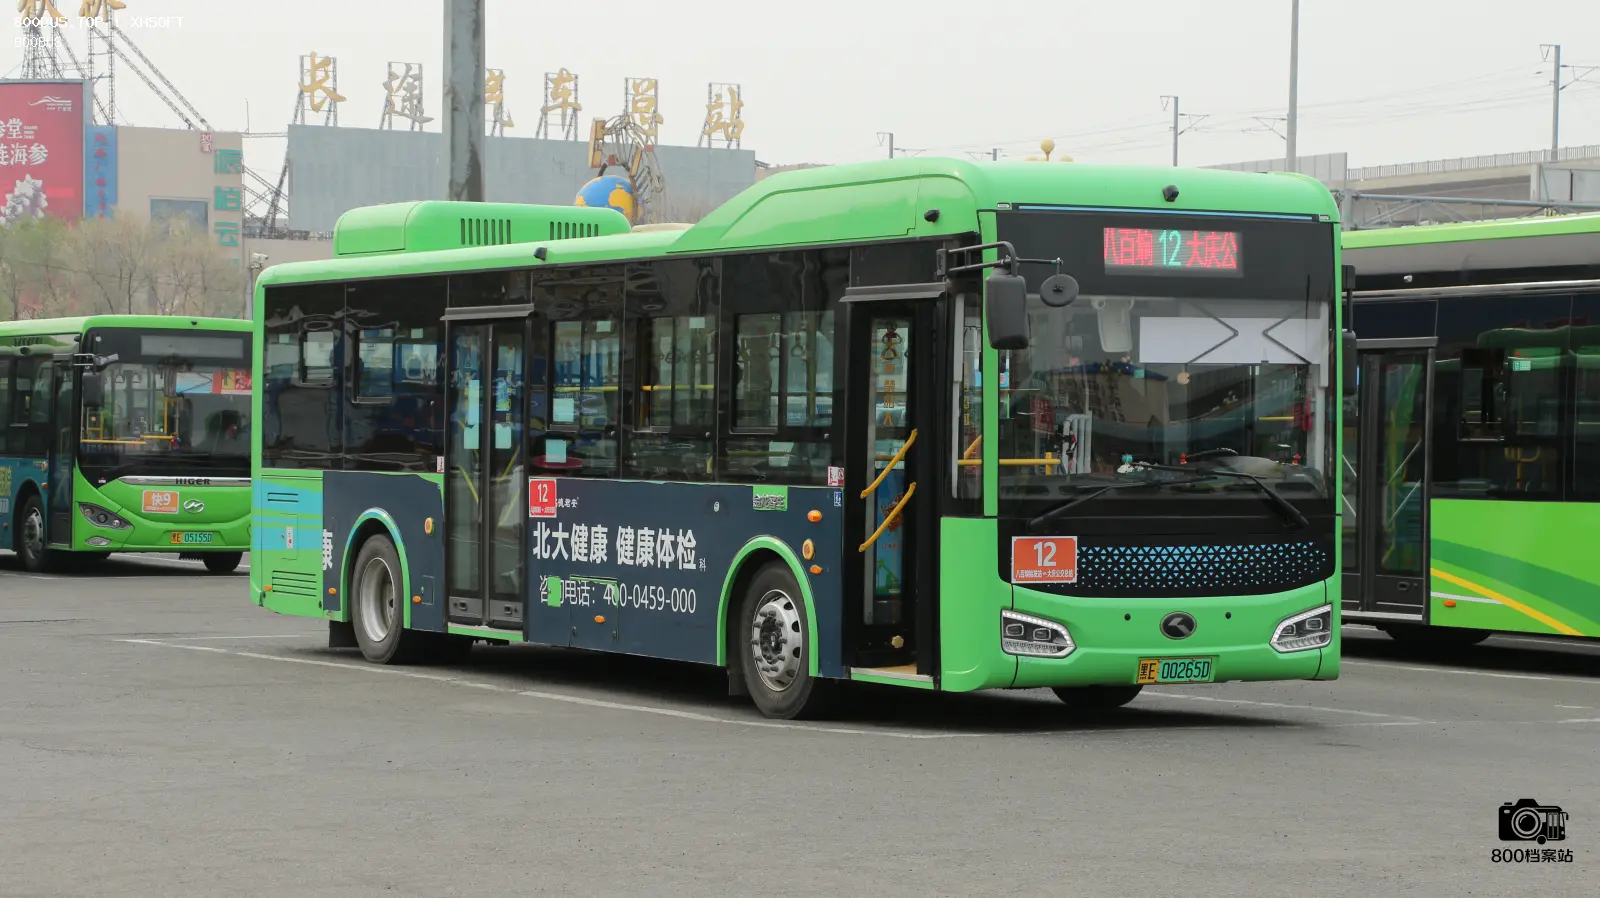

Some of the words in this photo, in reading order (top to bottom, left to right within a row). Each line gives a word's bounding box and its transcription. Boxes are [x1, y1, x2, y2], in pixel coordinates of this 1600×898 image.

[1159, 229, 1182, 267] 12
[537, 483, 549, 503] 12
[532, 521, 609, 565] 北大健康
[615, 525, 698, 571] 健康体检
[1033, 541, 1057, 567] 12
[539, 574, 596, 607] 咨电话：
[1139, 662, 1157, 680] 黑E
[1161, 661, 1210, 680] 00265D
